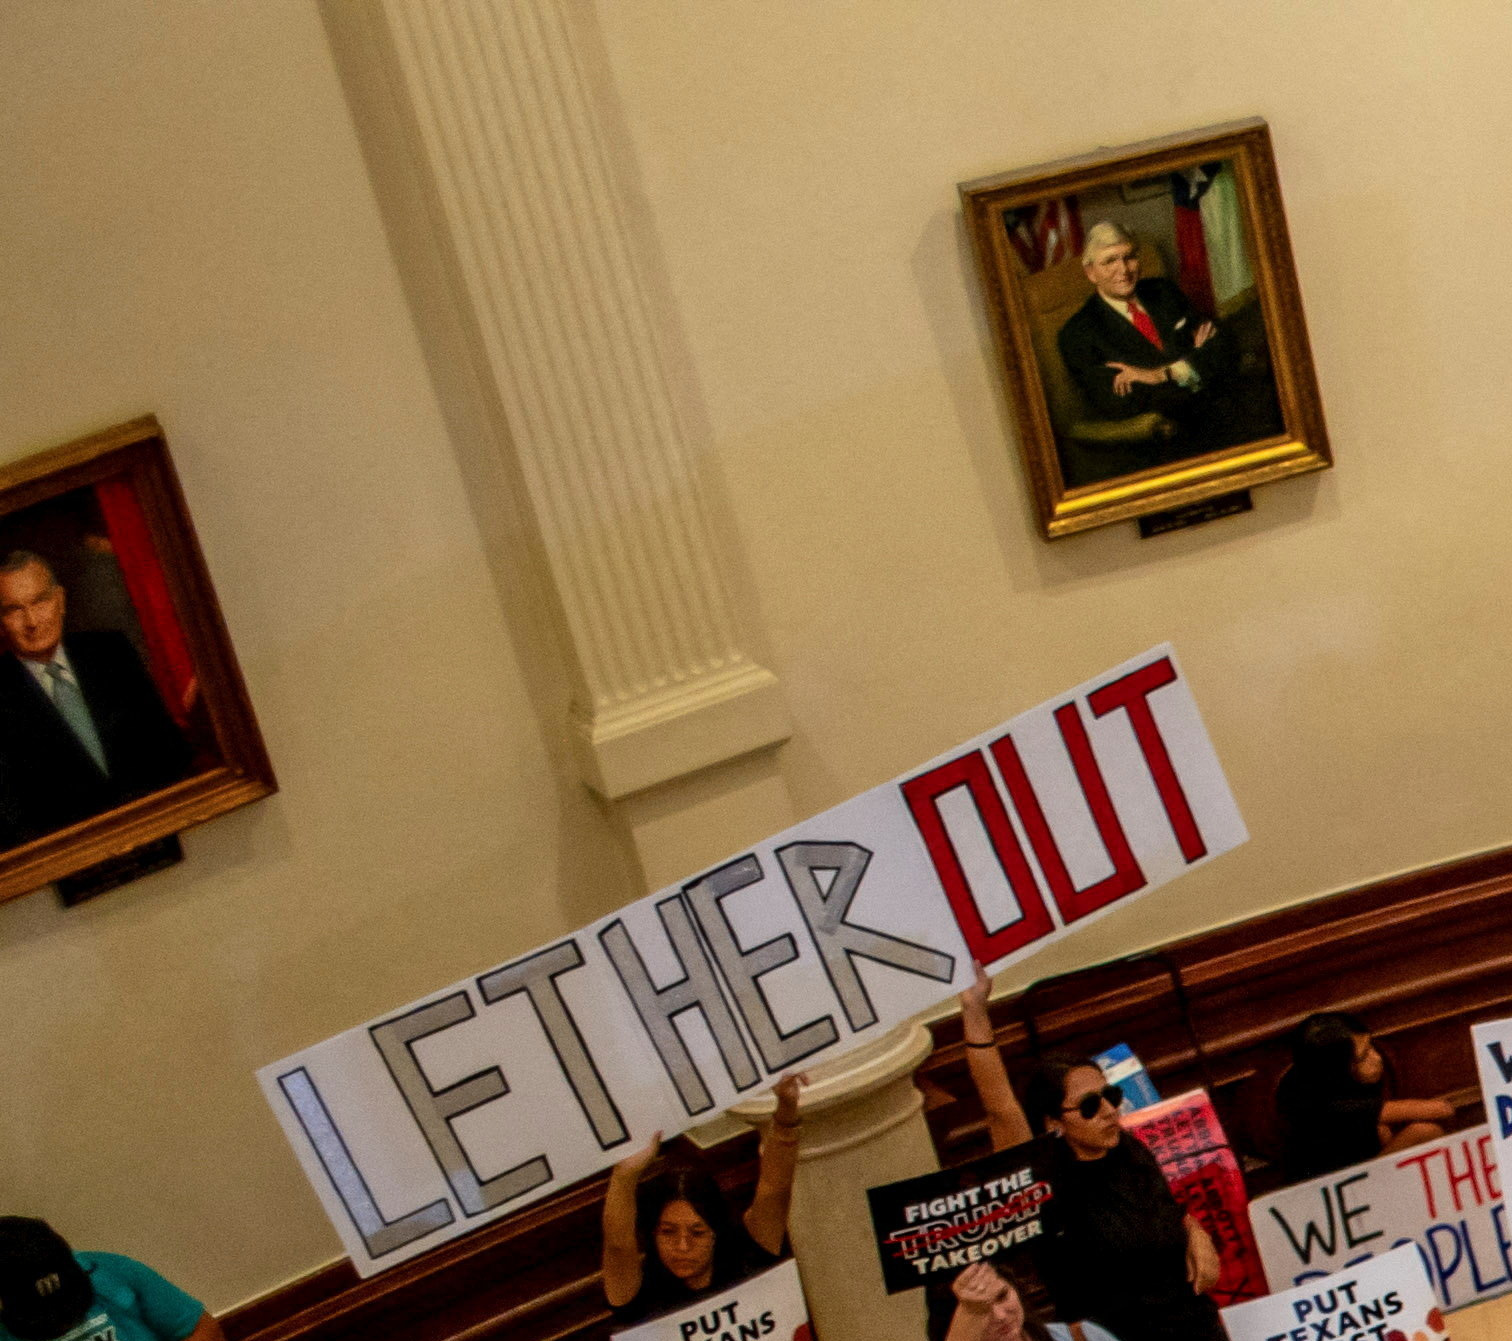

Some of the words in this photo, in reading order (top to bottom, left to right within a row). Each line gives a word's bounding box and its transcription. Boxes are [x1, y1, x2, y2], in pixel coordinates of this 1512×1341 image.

[900, 655, 1209, 967] OUT
[890, 1182, 1052, 1259] TRUMP
[905, 1187, 979, 1223] FIGHT
[986, 1170, 1033, 1200] THE
[1269, 1171, 1383, 1265] WE
[1396, 1135, 1503, 1219] THE
[911, 1221, 1043, 1274] TAKEOVER
[1293, 1280, 1358, 1323] PUT
